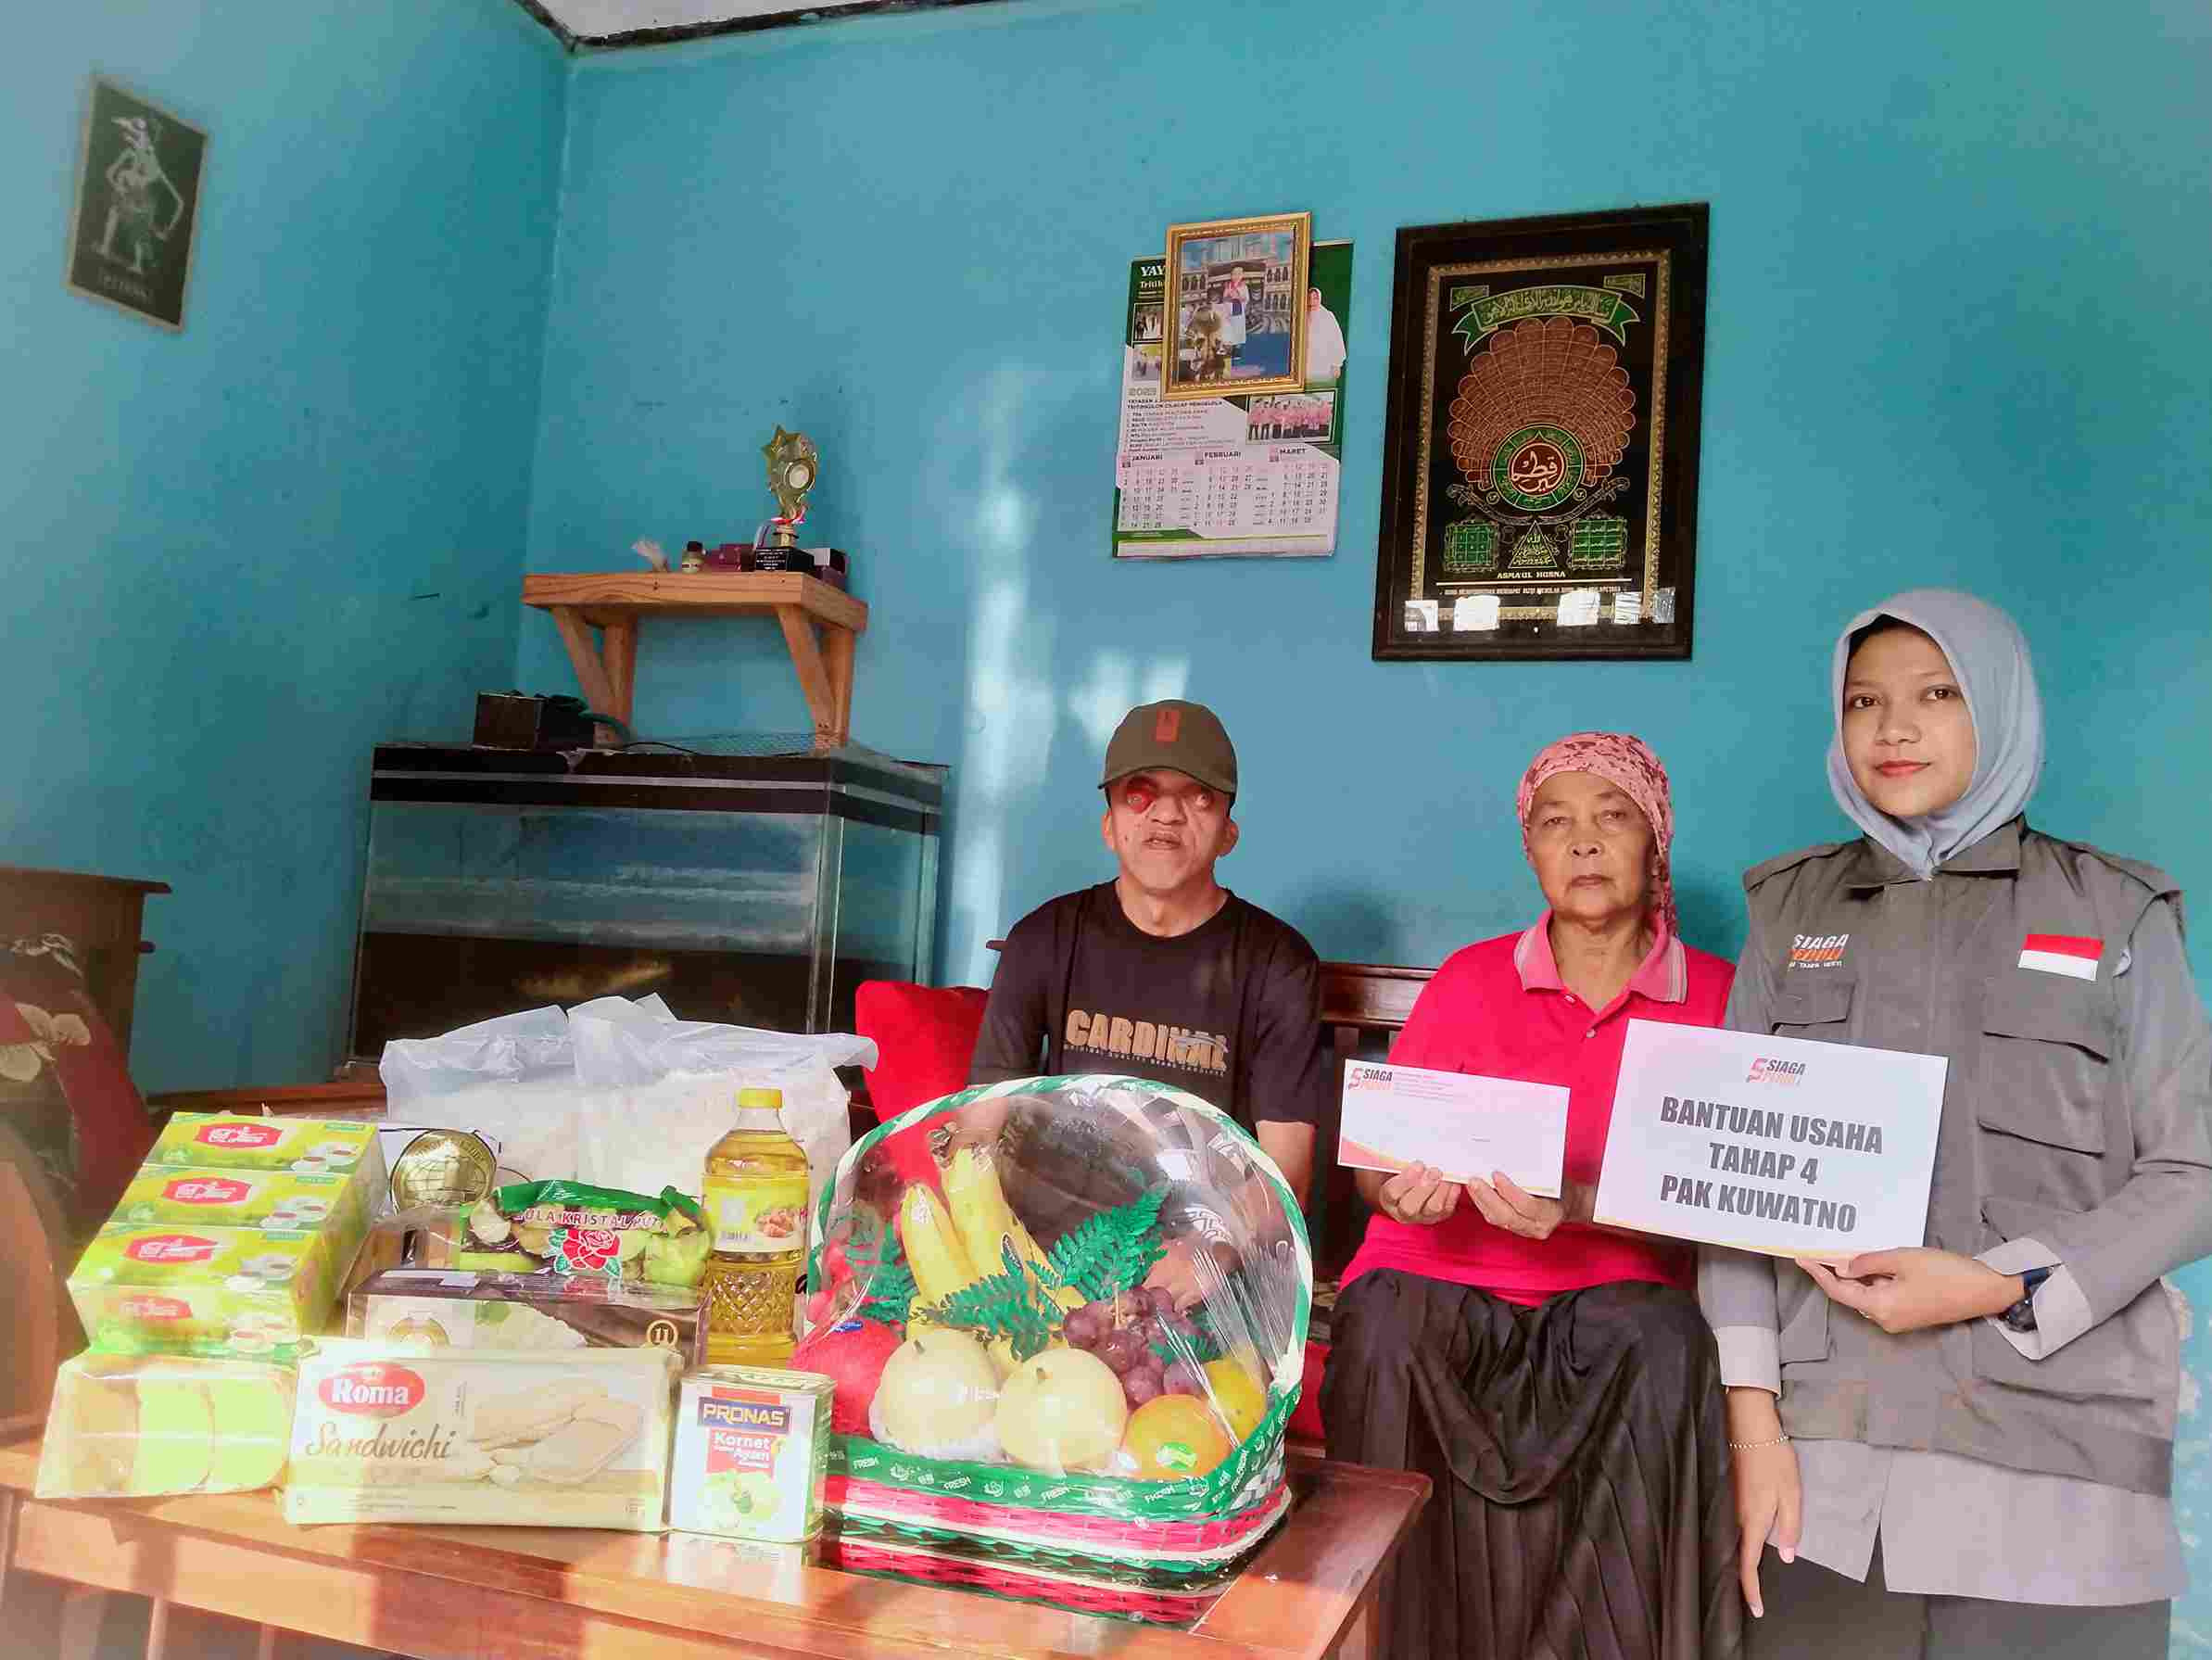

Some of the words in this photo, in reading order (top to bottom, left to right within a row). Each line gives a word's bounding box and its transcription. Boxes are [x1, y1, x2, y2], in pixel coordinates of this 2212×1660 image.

[1792, 933, 1850, 949] SIAGA
[1067, 1009, 1229, 1071] CARDINAL
[1363, 1069, 1394, 1082] SIAGA
[1766, 1059, 1806, 1075] SIAGA
[1660, 1096, 1785, 1139] BANTUAN
[1789, 1115, 1883, 1155] USAHA
[1709, 1142, 1796, 1180] TAHAP
[1800, 1158, 1819, 1185] 4
[1660, 1174, 1713, 1210] PAK
[1717, 1185, 1857, 1233] KUWATNO
[332, 1379, 410, 1405] Roma
[702, 1402, 785, 1427] PRONAS
[306, 1421, 457, 1461] Sandwichi
[714, 1432, 771, 1451] Kornet
